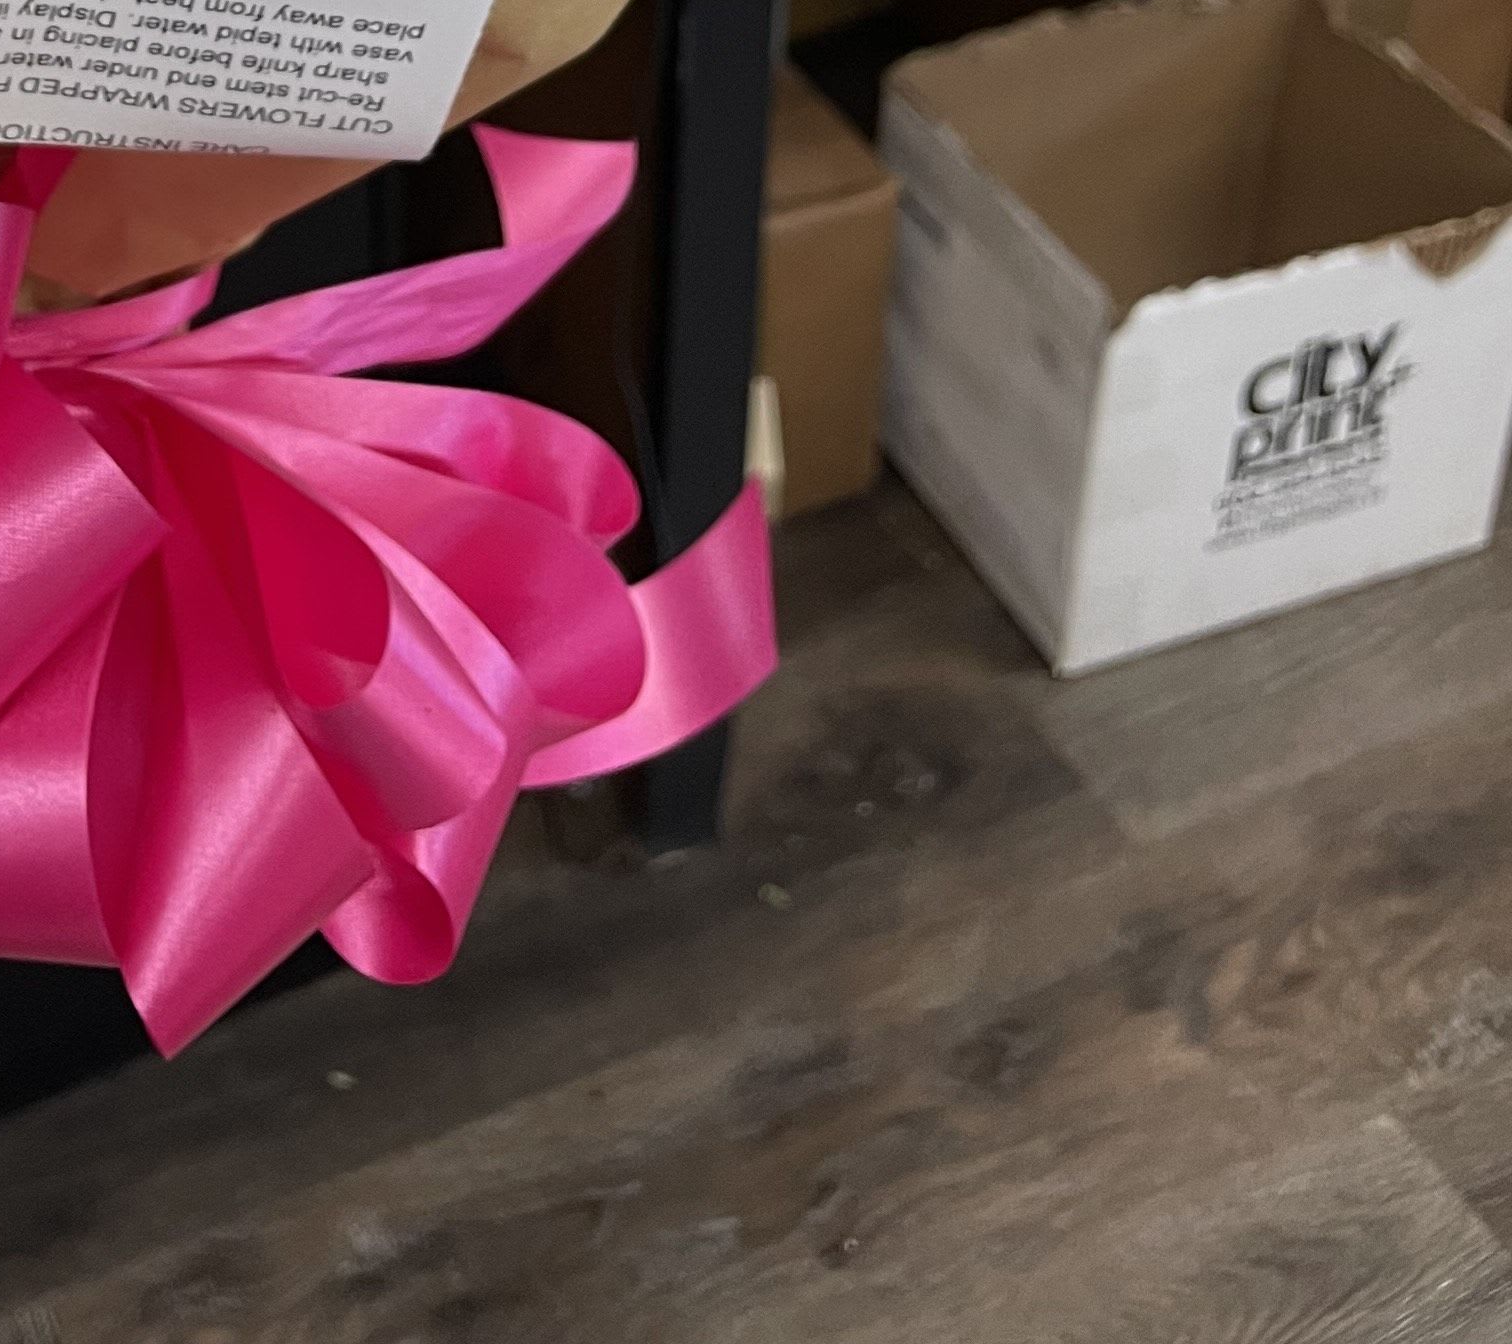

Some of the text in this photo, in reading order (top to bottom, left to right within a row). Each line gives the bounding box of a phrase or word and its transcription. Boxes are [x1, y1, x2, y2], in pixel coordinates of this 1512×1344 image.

[128, 14, 208, 37] water.
[273, 4, 344, 28] away
[11, 28, 34, 44] in
[42, 26, 140, 54] placing
[214, 26, 281, 49] tepid
[352, 19, 426, 41] place
[147, 43, 232, 68] before
[290, 36, 344, 57] with
[351, 44, 414, 64] vase
[80, 59, 159, 80] under
[241, 54, 306, 78] knife
[312, 63, 389, 86] sharp
[166, 70, 217, 88] end
[225, 78, 290, 98] stem
[18, 77, 170, 112] WRAPPED
[298, 86, 386, 112] Re-cut
[176, 97, 326, 128] FLOWERS
[329, 115, 393, 135] CUT
